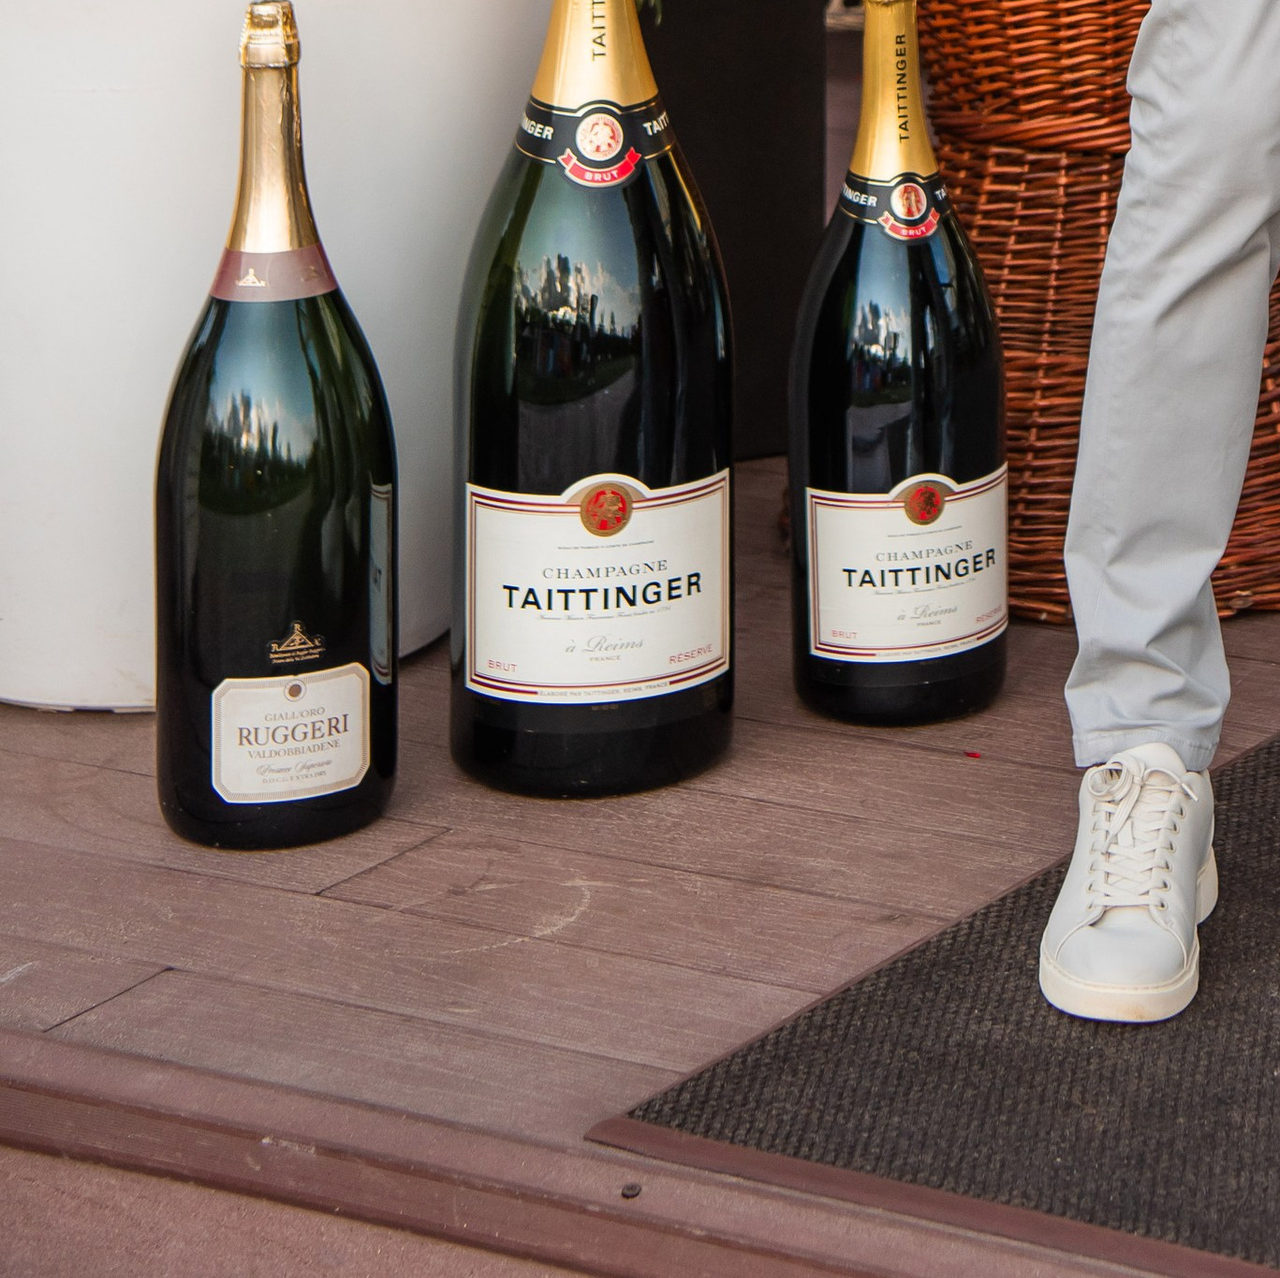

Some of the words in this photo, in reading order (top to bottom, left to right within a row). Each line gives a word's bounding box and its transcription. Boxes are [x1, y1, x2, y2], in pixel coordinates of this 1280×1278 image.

[895, 34, 910, 144] TAITTINGER
[584, 170, 618, 181] BRUT
[901, 228, 927, 236] BRUT
[876, 540, 973, 562] CHAMPAGNE
[542, 559, 668, 580] CHAMPAGNE
[843, 548, 996, 588] TAITTINGER
[503, 572, 702, 611] TAITTINGER
[910, 603, 958, 620] Reims
[565, 639, 576, 653] à
[582, 634, 644, 653] Reims
[832, 630, 858, 640] BRUT
[487, 659, 517, 673] BRUT
[589, 654, 621, 662] FRANCE
[264, 706, 325, 722] GIALL'ORO
[237, 714, 349, 746] RUGGERI
[248, 740, 340, 759] VALDOBBIADENE
